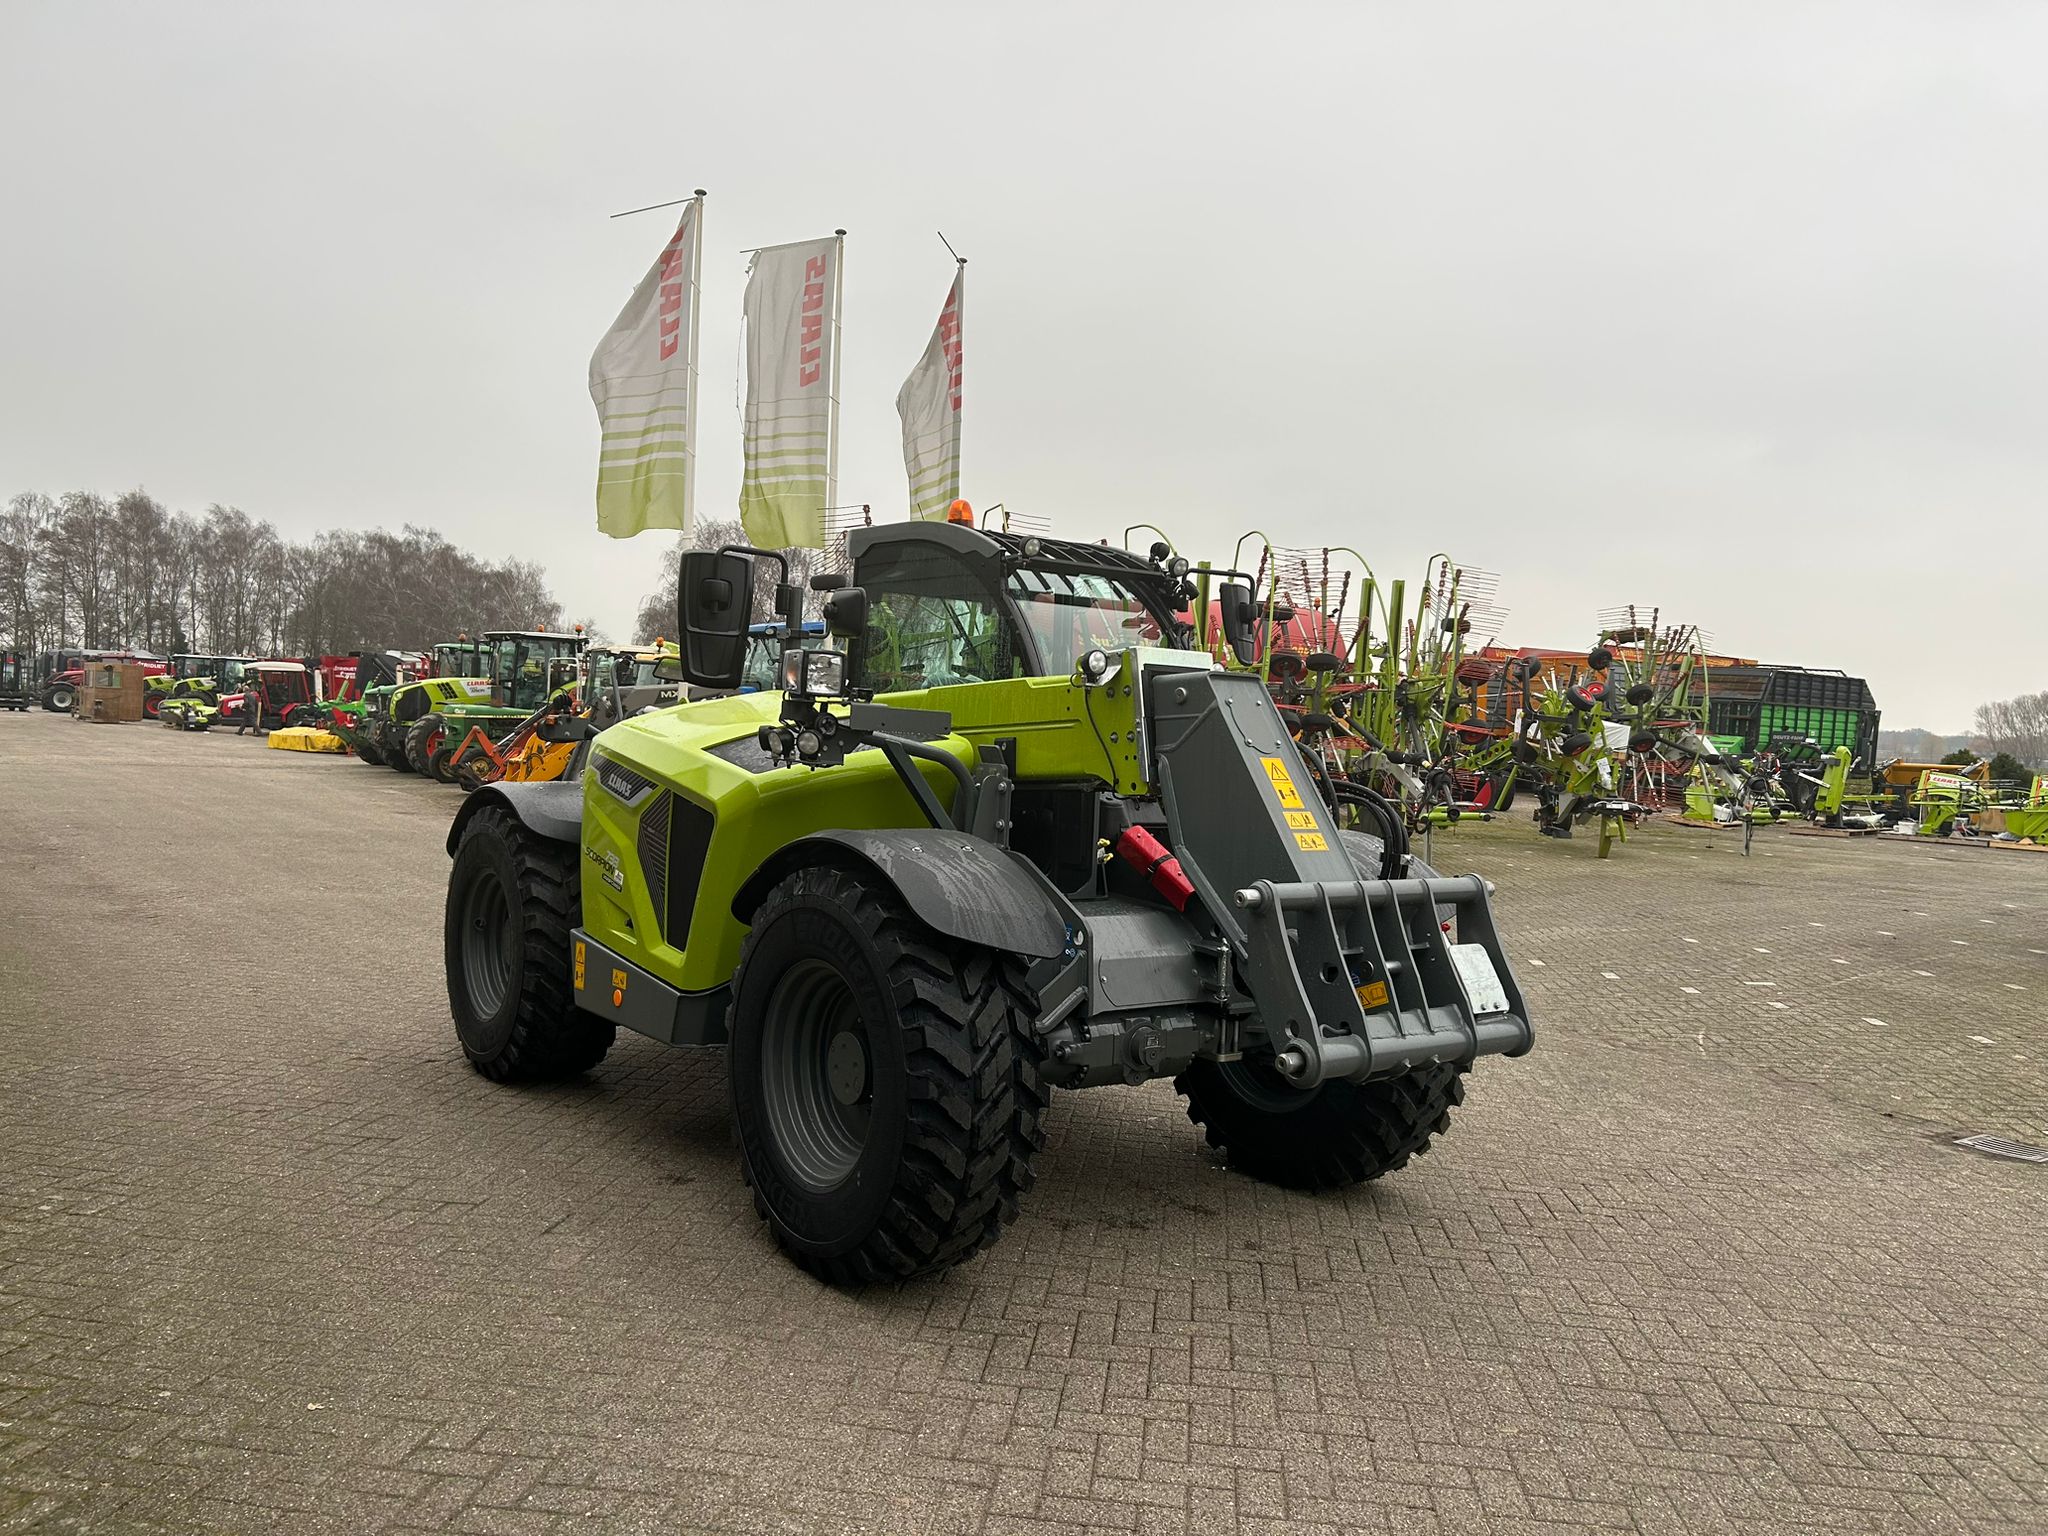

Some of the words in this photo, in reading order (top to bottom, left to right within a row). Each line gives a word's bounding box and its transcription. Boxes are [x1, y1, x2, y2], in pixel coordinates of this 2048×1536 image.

[608, 773, 632, 797] CLAAS
[1933, 777, 1957, 785] CLAAS
[585, 847, 615, 875] SCORPION
